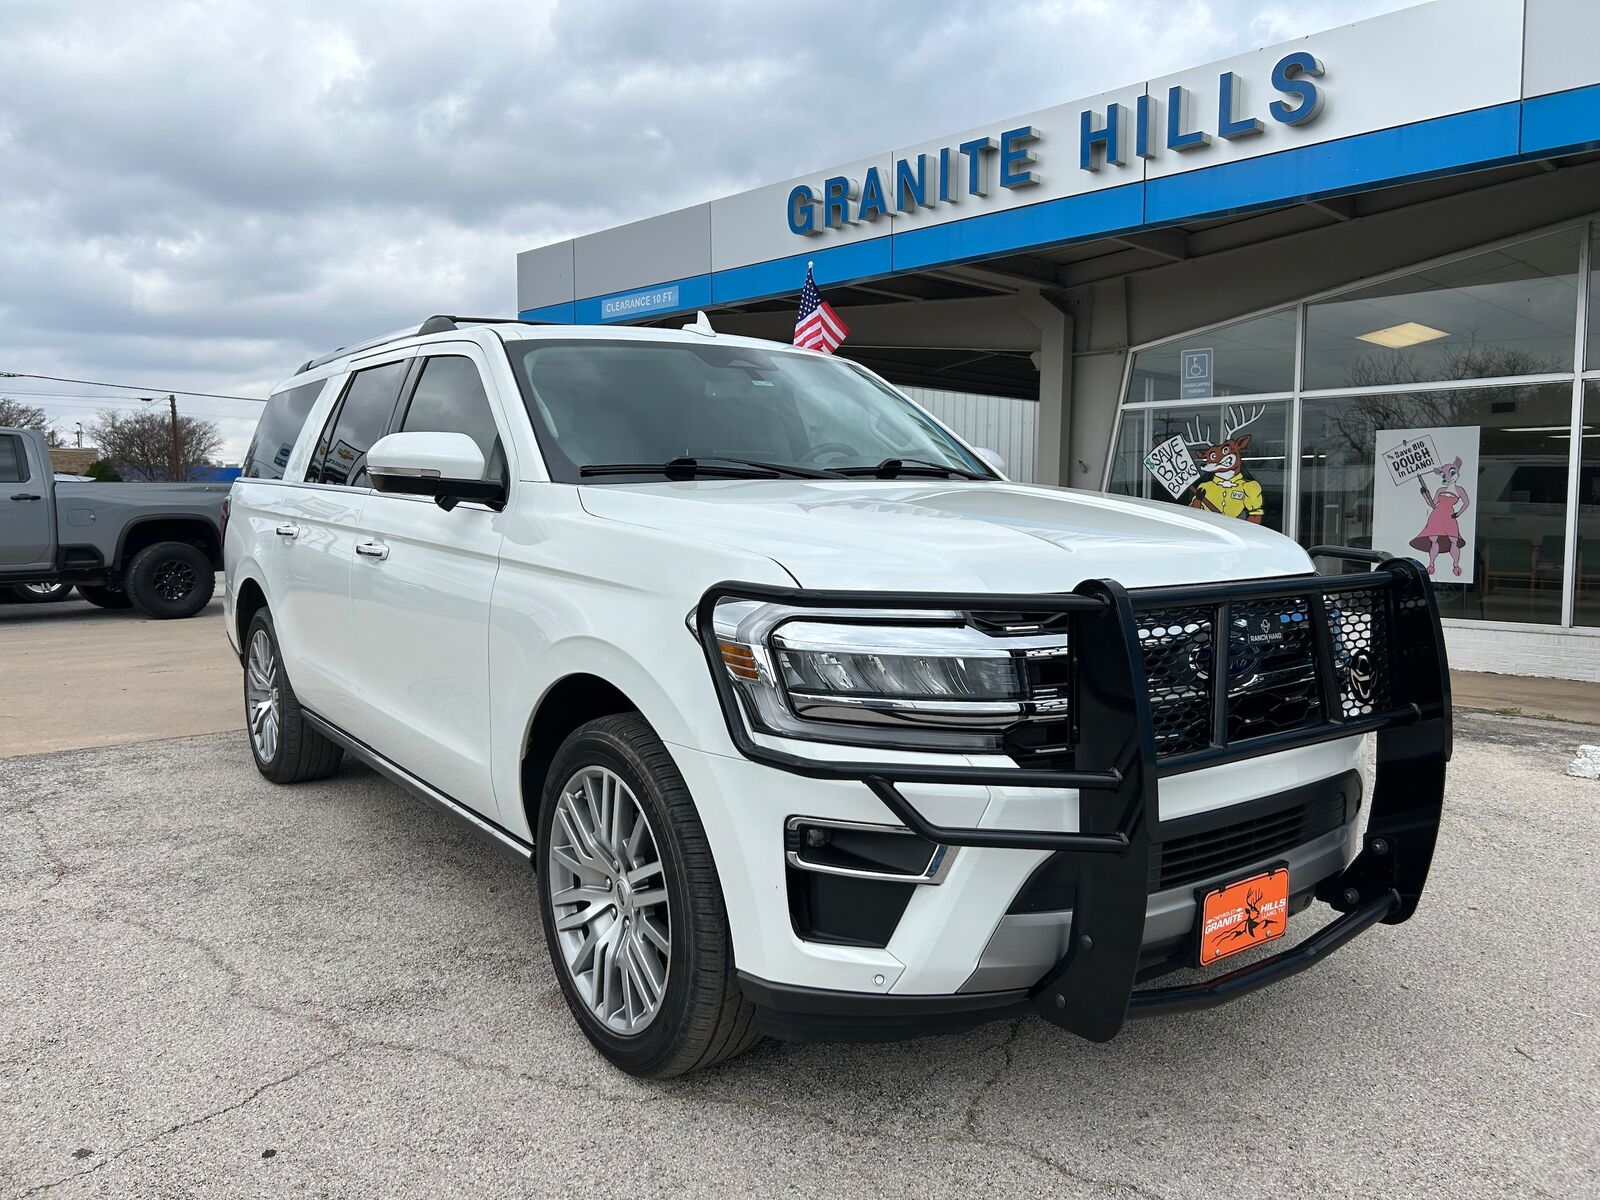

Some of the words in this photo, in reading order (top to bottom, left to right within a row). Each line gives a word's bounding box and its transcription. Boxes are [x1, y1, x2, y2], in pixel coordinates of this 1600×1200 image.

[788, 125, 1040, 236] GRANITE
[1080, 51, 1325, 172] HILLS
[606, 295, 651, 312] CLEARANCE
[652, 294, 661, 304] 10
[663, 291, 673, 302] FT
[1151, 438, 1183, 466] SAVE
[1392, 447, 1431, 472] DOUGH
[1394, 448, 1412, 459] Save
[1412, 440, 1425, 451] BIG
[1157, 453, 1188, 482] BIG
[1406, 457, 1435, 474] LLANO!
[1168, 464, 1198, 494] BUCKS
[1250, 634, 1268, 642] RANCH
[1205, 912, 1244, 935] GRANITE
[1260, 898, 1287, 913] HILLS
